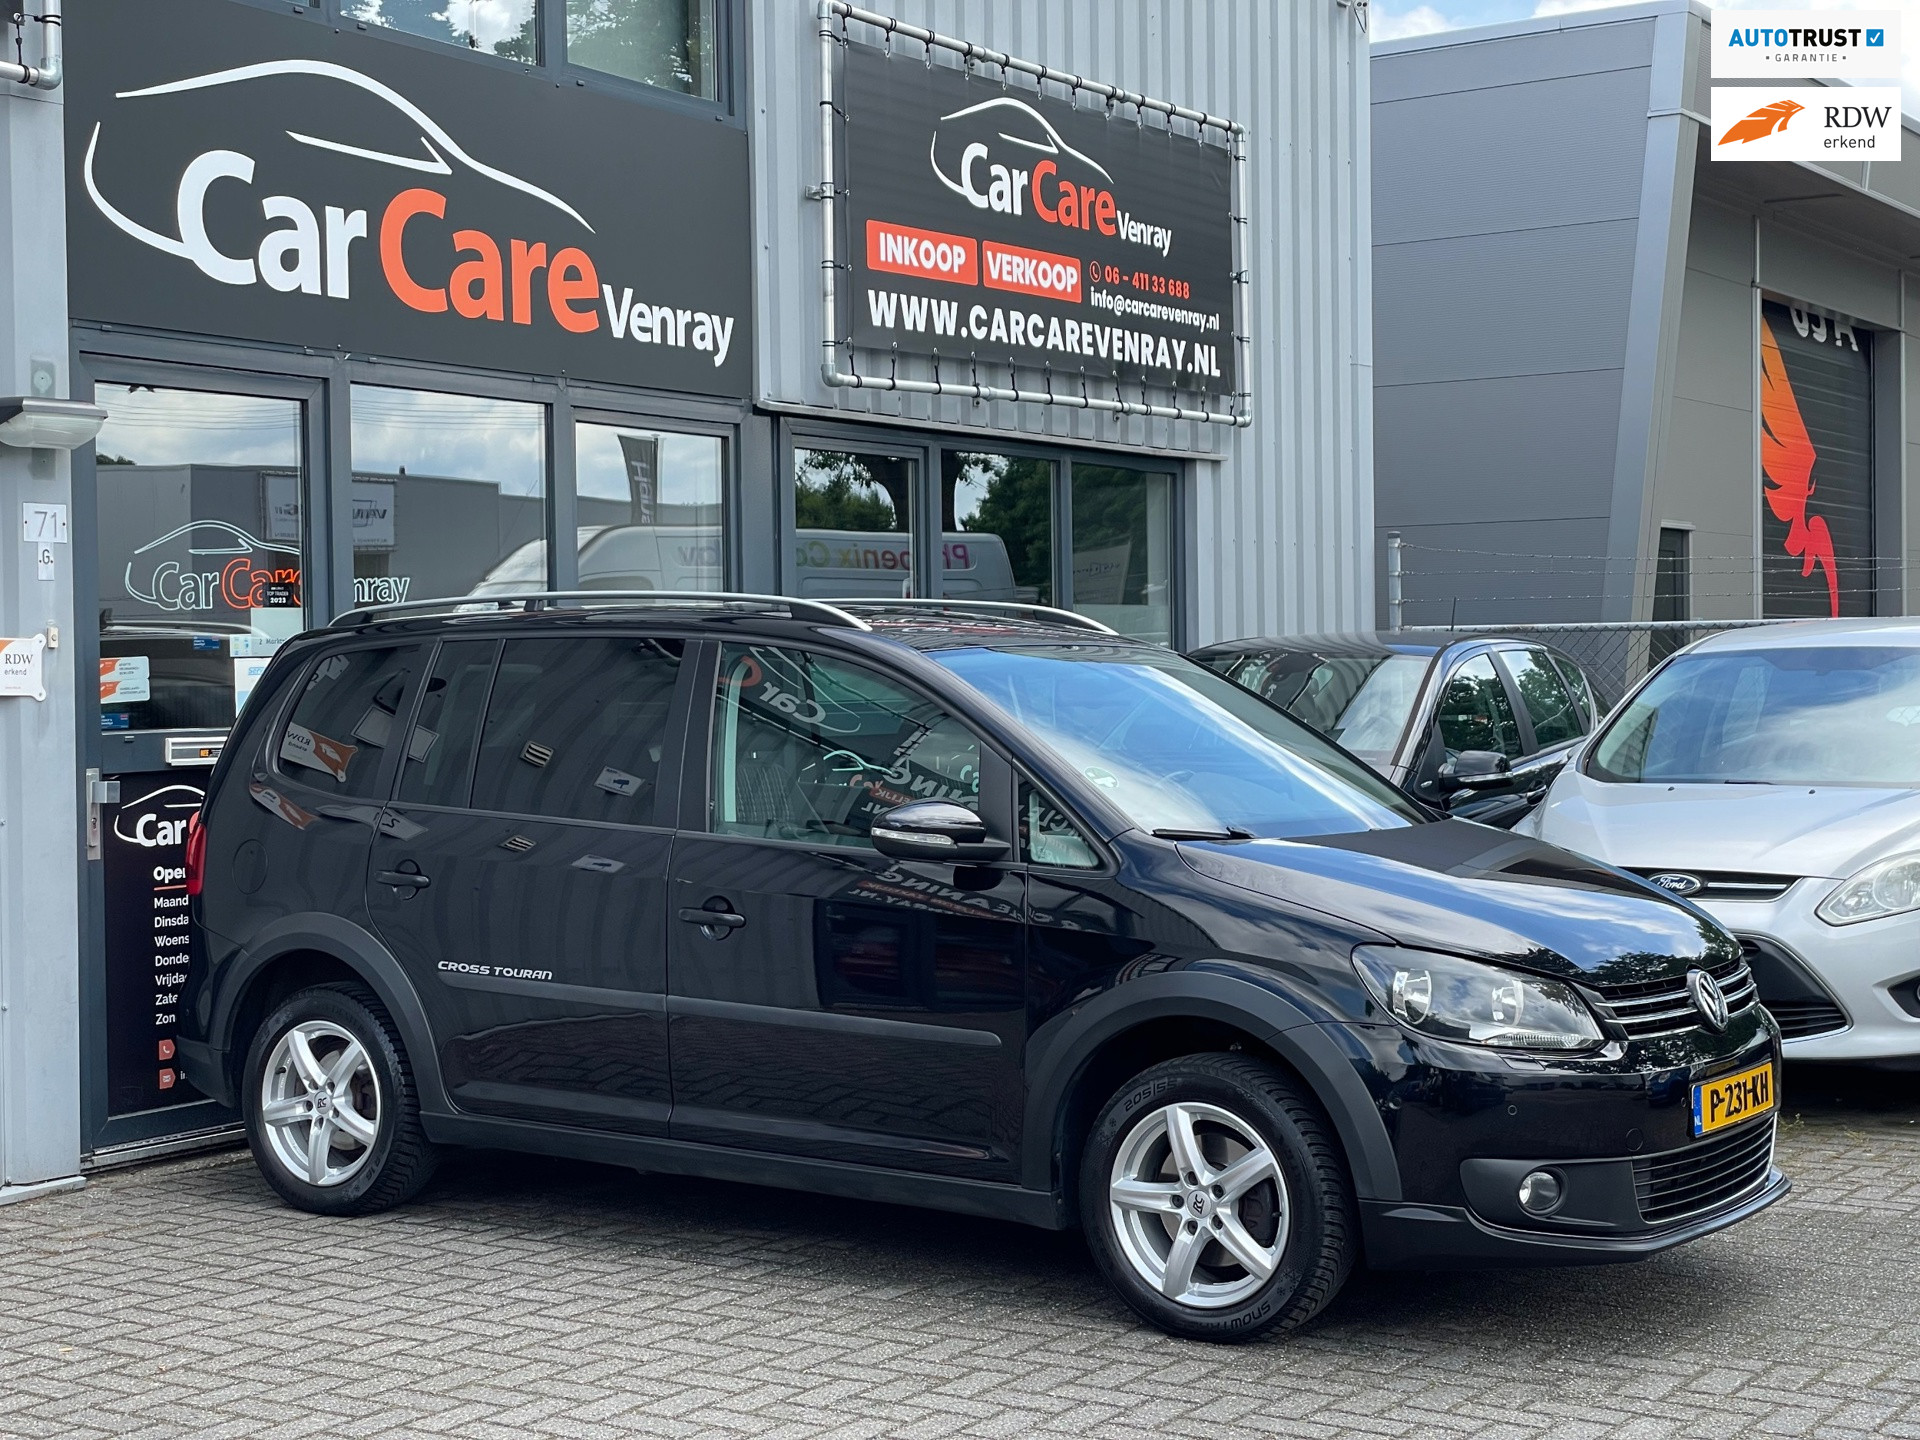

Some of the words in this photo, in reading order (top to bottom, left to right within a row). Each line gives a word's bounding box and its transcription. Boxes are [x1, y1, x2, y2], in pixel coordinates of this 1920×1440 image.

[1117, 210, 1172, 257] Venray
[878, 233, 966, 274] INKOOP
[986, 250, 1079, 292] VERKOOP
[1105, 265, 1120, 285] 06
[1131, 271, 1150, 290] 411
[1152, 275, 1167, 294] 33
[1168, 279, 1191, 299] 688
[602, 284, 734, 366] Venray
[1090, 286, 1220, 334] info@carcarevenray.nl
[867, 288, 1222, 378] WWW.CARCAREVENRAY.NL
[34, 510, 57, 538] 71
[42, 548, 51, 565] G
[4, 668, 27, 676] erkend
[5, 653, 33, 665] RDW
[136, 811, 200, 848] Car
[1657, 876, 1687, 890] Ford
[155, 972, 187, 987] Vrijda
[437, 960, 490, 975] CROSS
[493, 966, 553, 980] TOURAN
[1710, 1070, 1769, 1124] P-231-KH
[1694, 1114, 1702, 1127] NL
